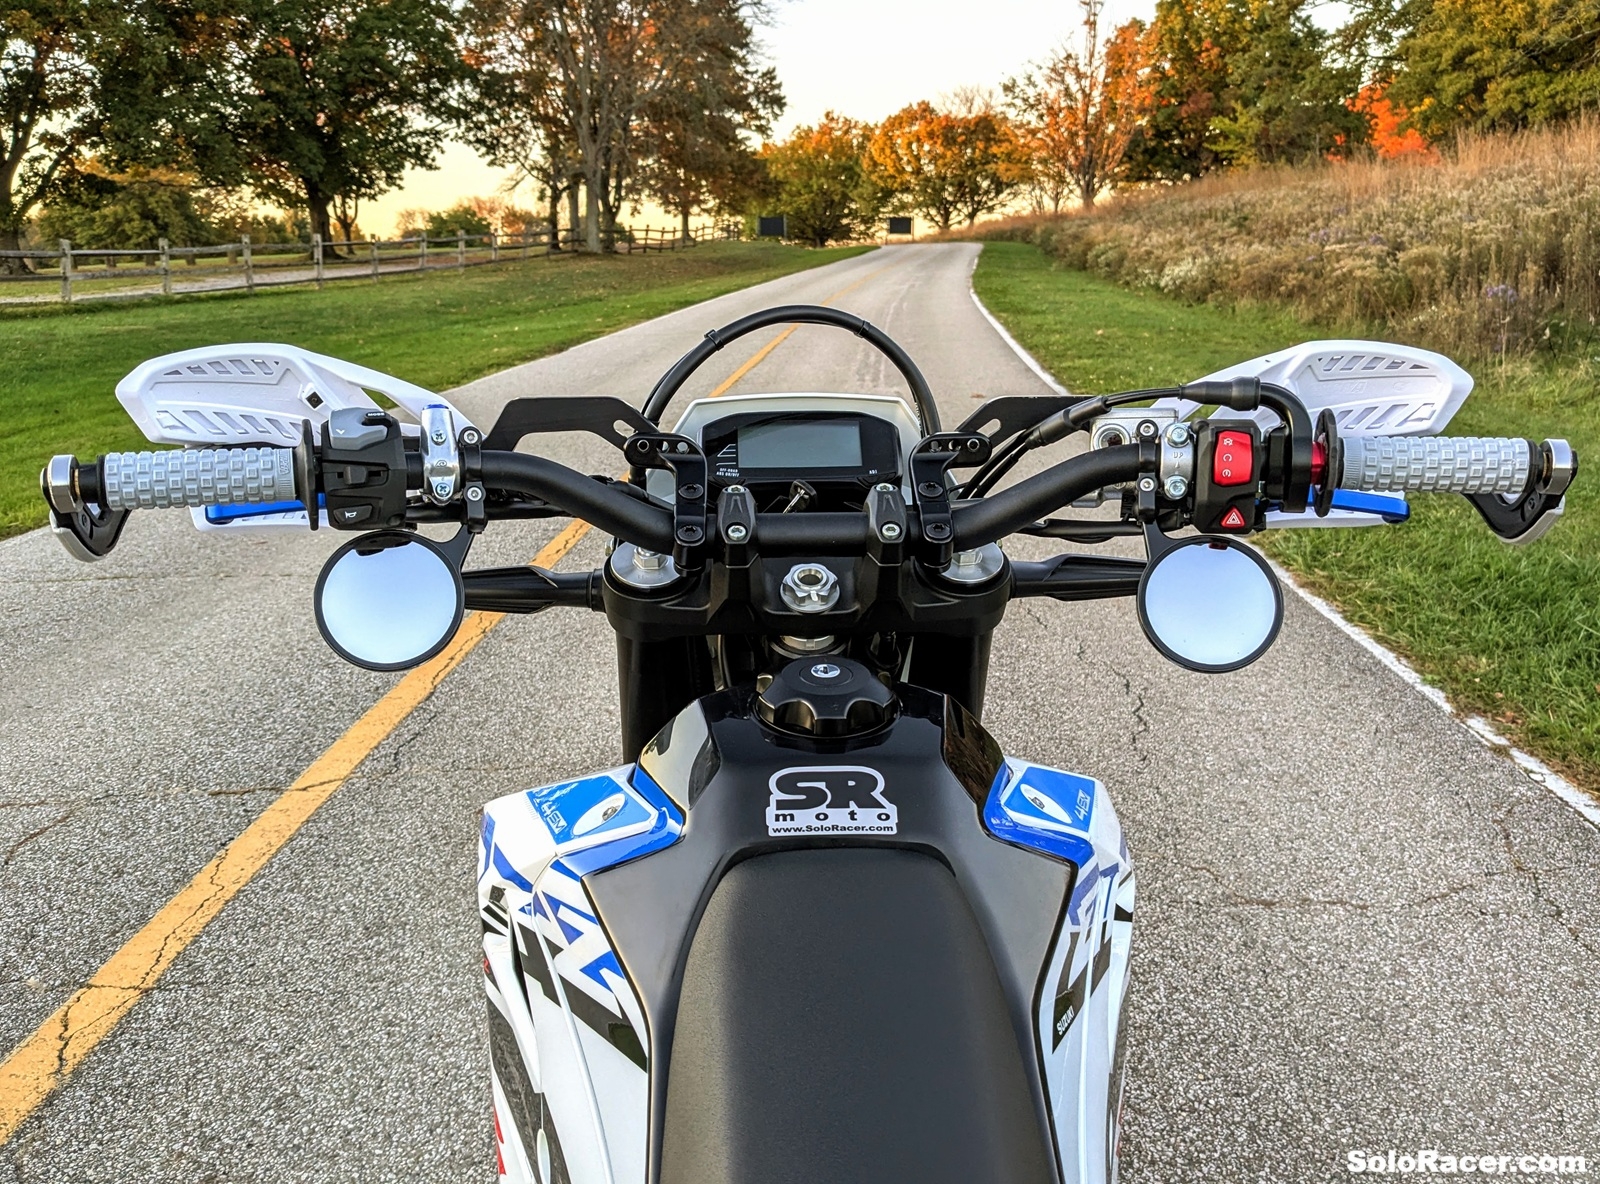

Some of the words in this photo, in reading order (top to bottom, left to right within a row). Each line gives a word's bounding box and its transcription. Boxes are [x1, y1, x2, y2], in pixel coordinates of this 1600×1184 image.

[775, 771, 887, 811] SR
[774, 809, 891, 823] moto
[772, 824, 894, 834] www.SoloRacer.com
[1056, 1005, 1075, 1036] SUZUKI
